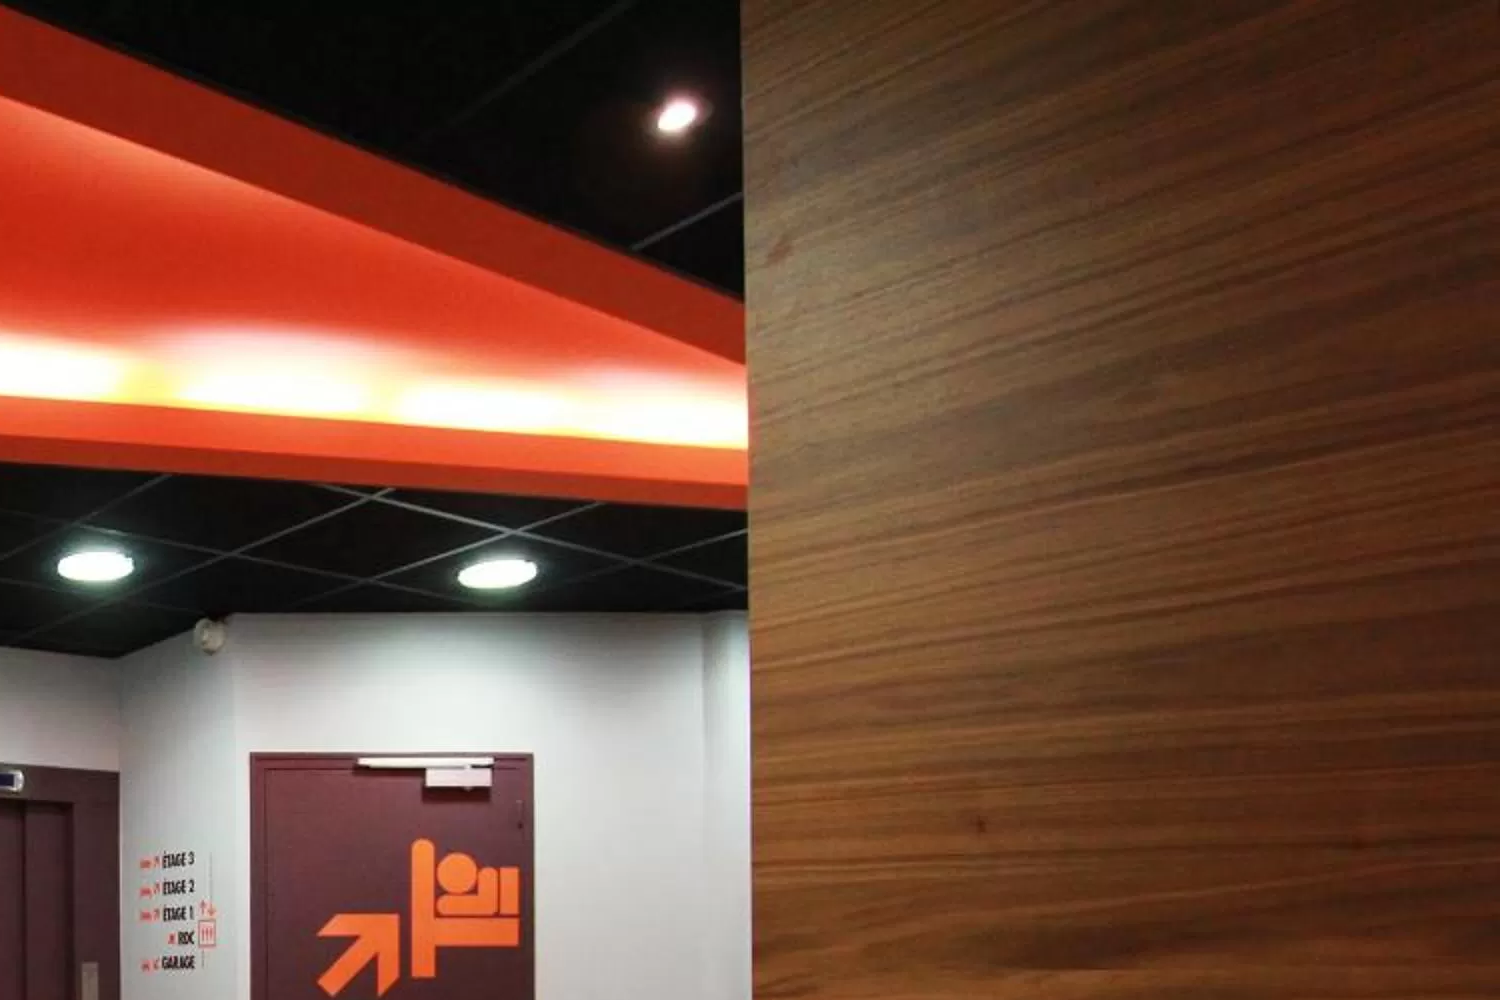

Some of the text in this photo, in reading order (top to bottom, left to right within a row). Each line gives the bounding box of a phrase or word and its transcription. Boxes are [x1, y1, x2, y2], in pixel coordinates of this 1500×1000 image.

[188, 851, 195, 866] 3
[188, 879, 195, 893] 2
[189, 905, 194, 920] 1
[161, 955, 195, 970] GARAGE
